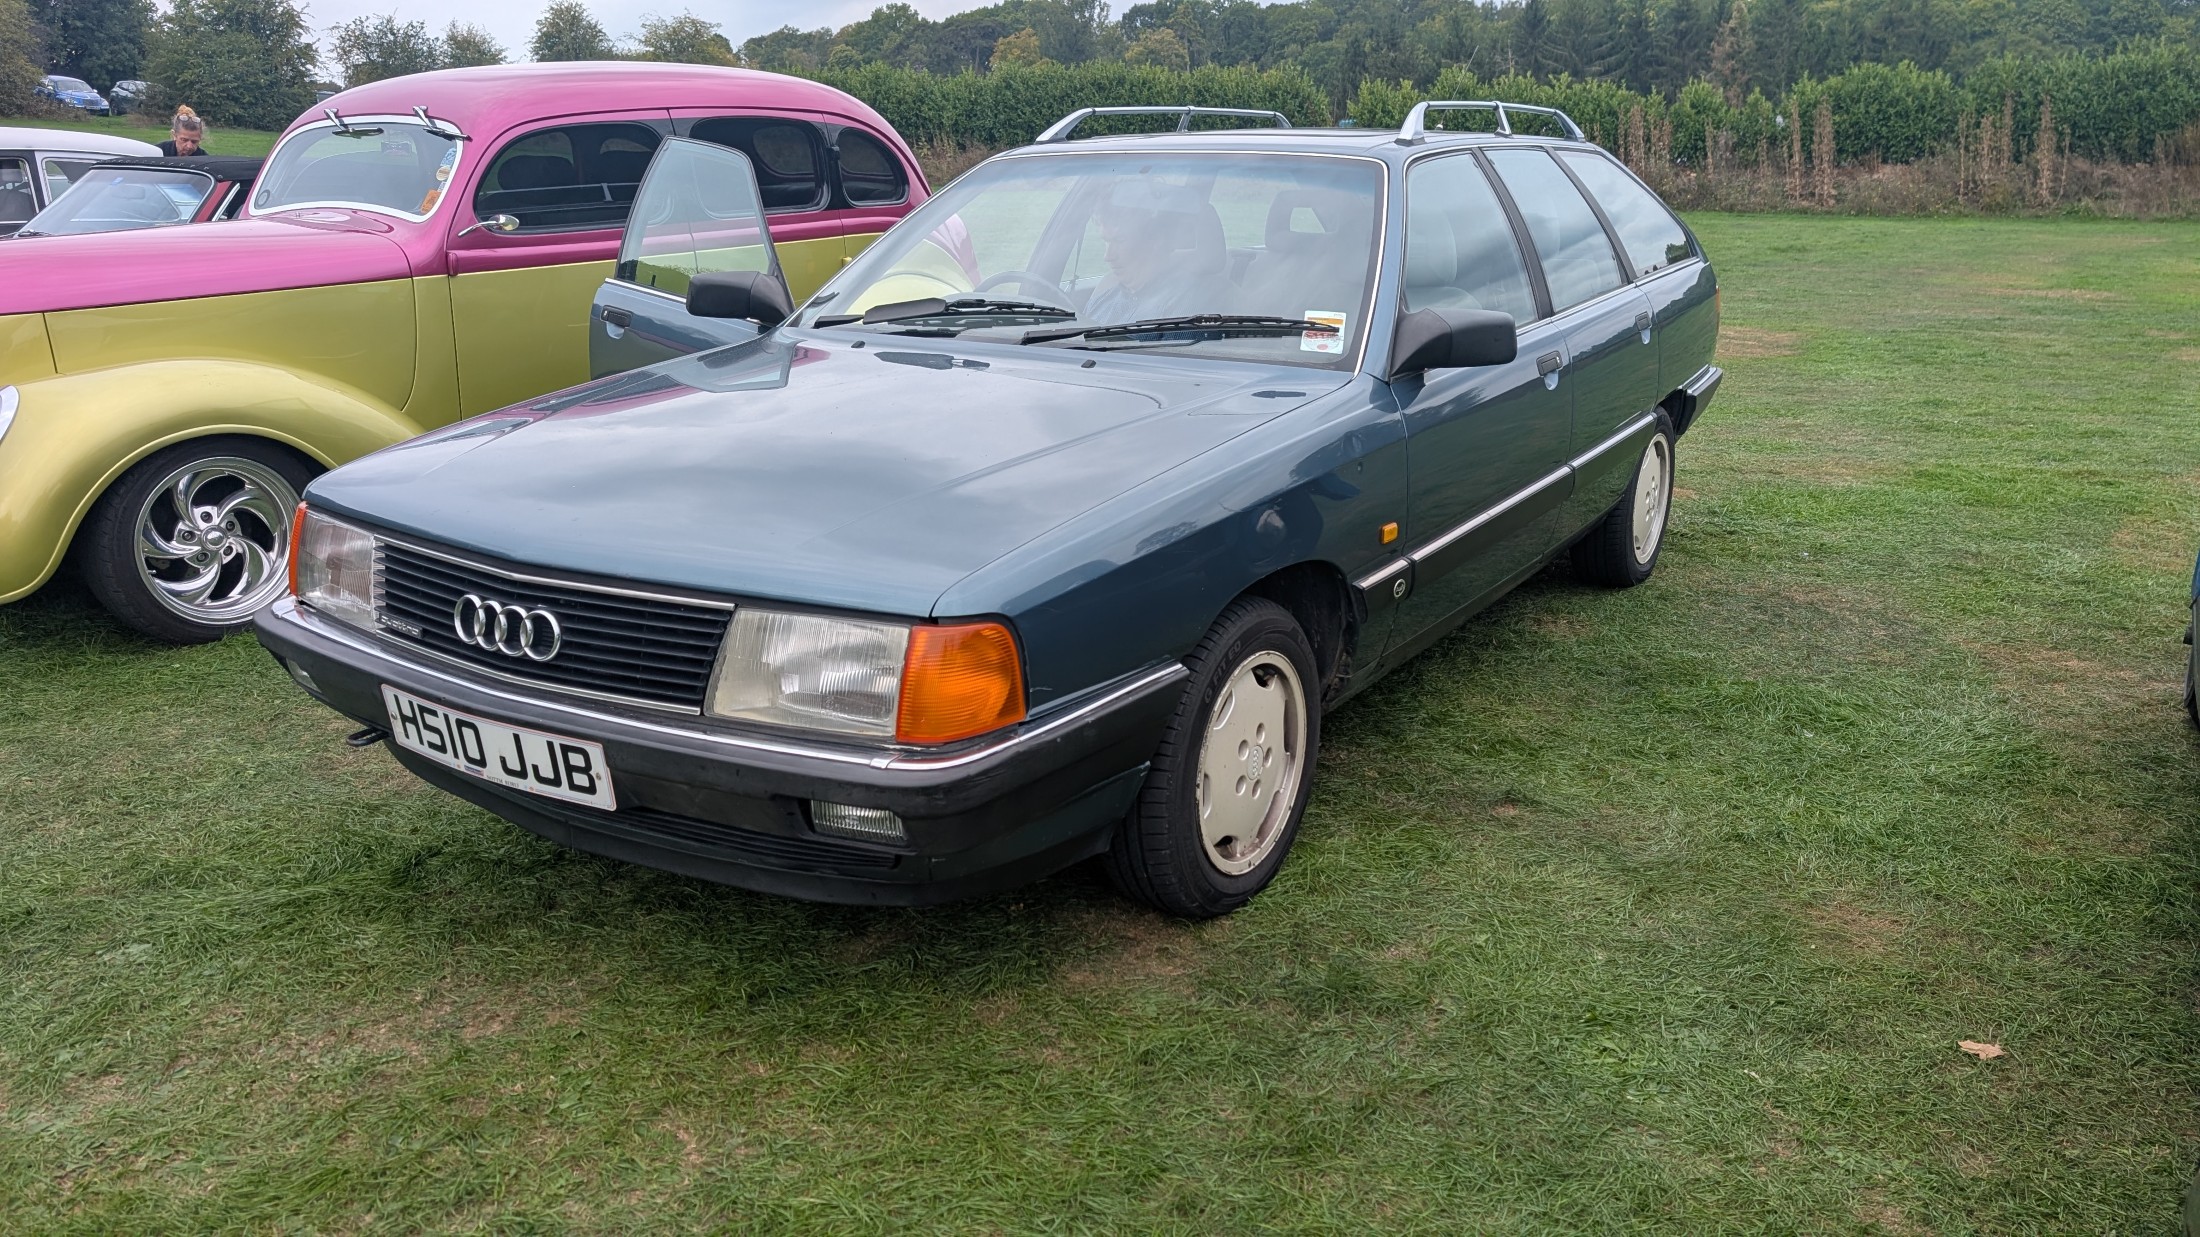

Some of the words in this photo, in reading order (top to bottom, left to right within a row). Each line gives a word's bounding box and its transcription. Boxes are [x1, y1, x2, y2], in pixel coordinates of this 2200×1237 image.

[1213, 657, 1228, 687] FIT
[394, 694, 487, 768] H510
[500, 733, 597, 795] JJB
